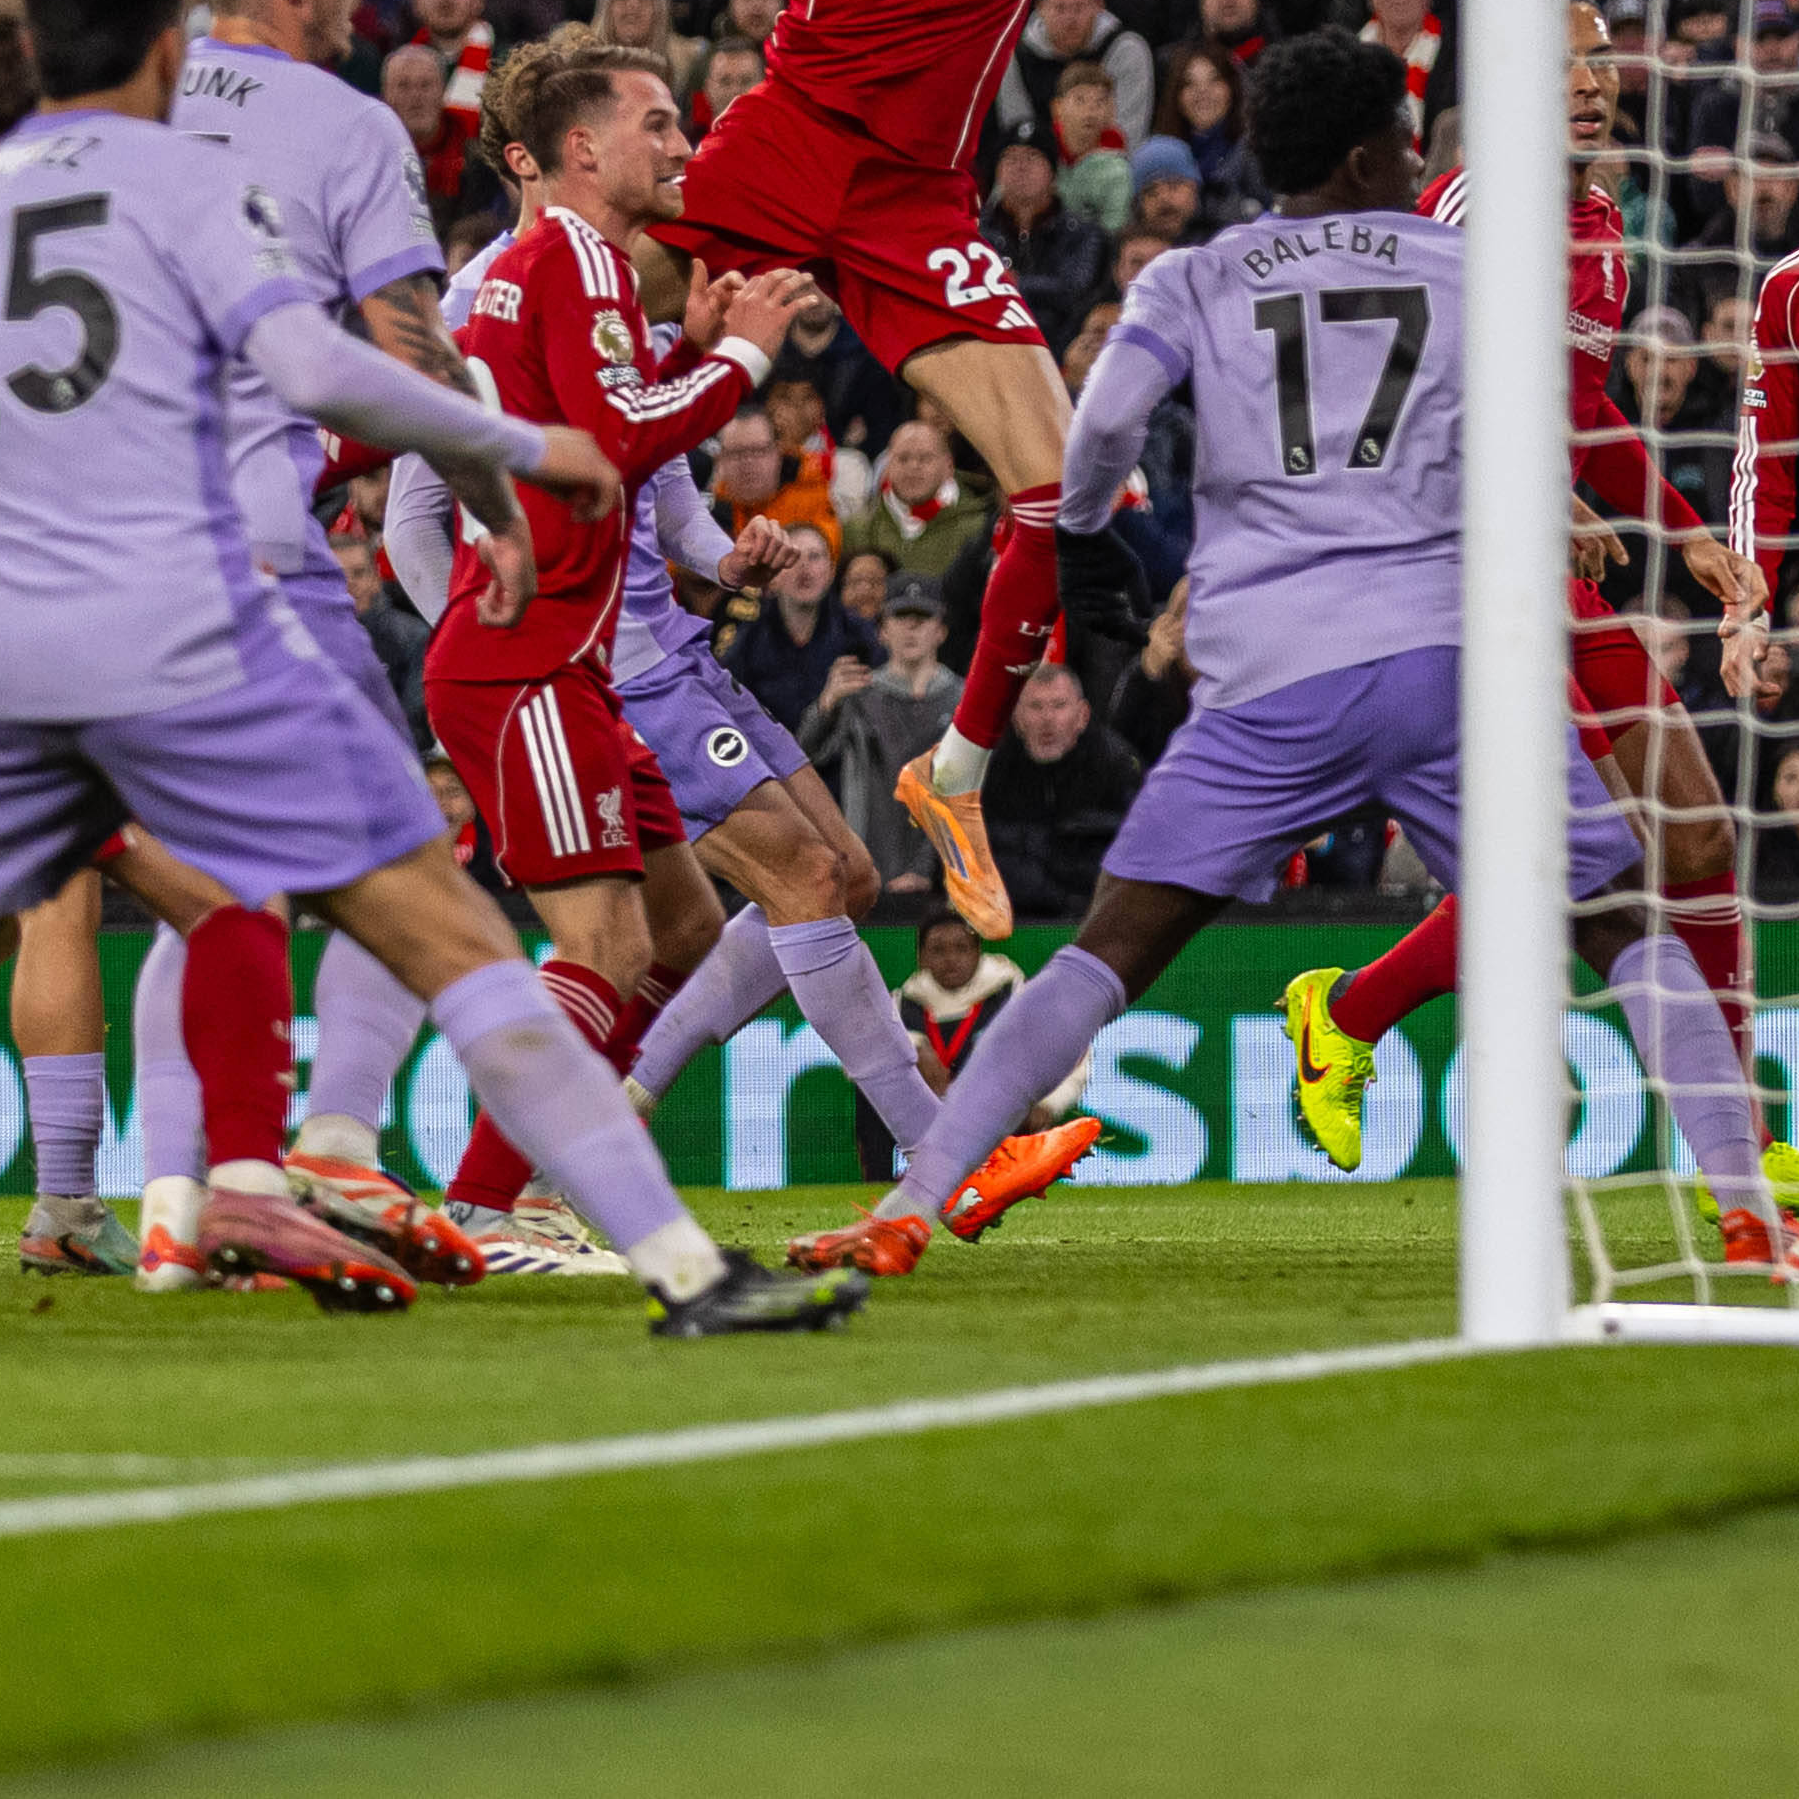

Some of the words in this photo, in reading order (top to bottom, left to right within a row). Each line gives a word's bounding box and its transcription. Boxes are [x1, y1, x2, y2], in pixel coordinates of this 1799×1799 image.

[182, 67, 264, 108] UNK
[927, 242, 1021, 308] 22
[1243, 220, 1403, 279] BALEBA
[1252, 284, 1432, 475] 17
